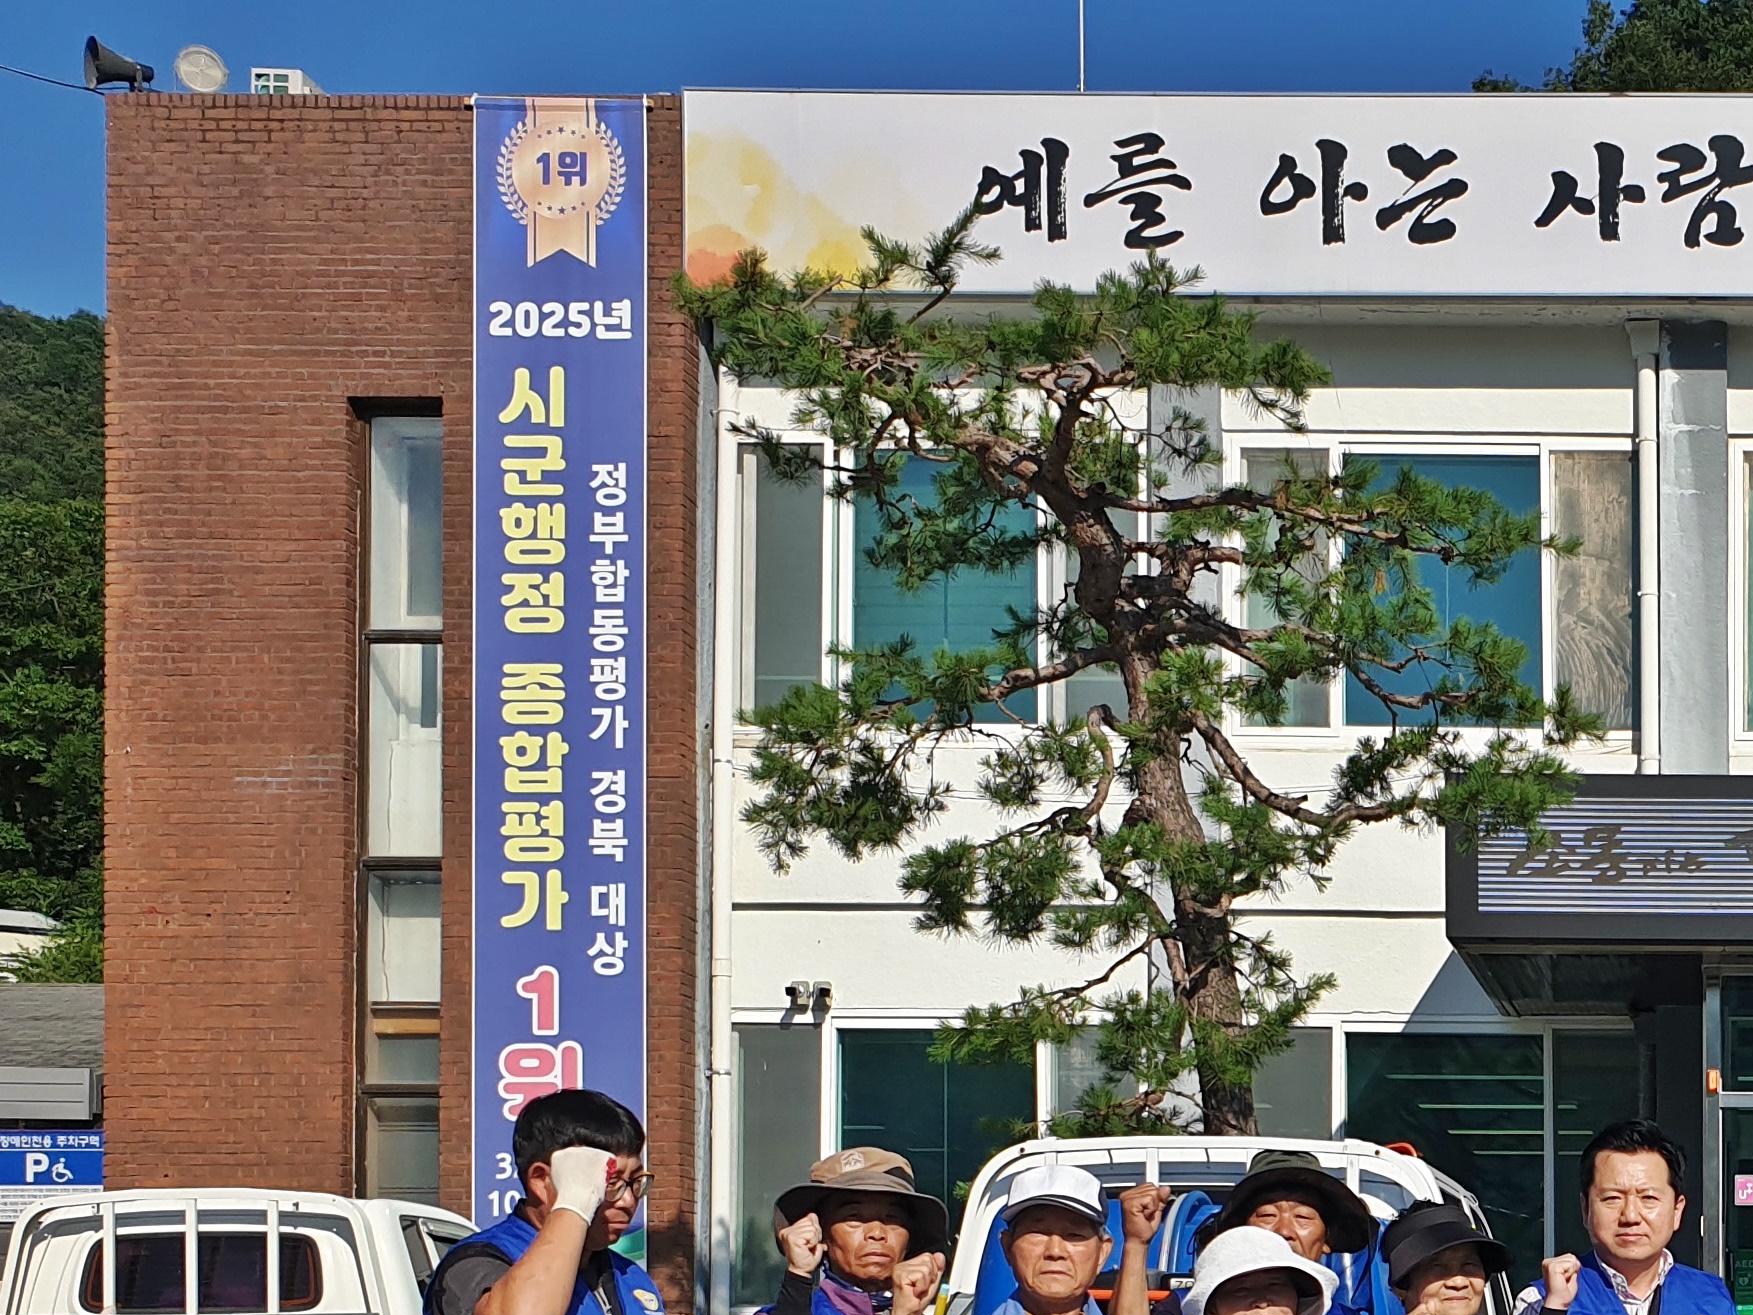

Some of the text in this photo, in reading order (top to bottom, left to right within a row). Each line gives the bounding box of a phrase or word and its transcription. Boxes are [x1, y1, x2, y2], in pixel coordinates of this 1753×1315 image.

[536, 152, 588, 187] 1위
[975, 133, 1193, 250] 예를
[1260, 138, 1469, 246] 아는
[488, 299, 633, 340] 2025년
[498, 366, 567, 633] 시군행정
[587, 462, 630, 976] 정부합동평가 경북 대상
[499, 663, 569, 931] 종합평가
[25, 1152, 50, 1183] P
